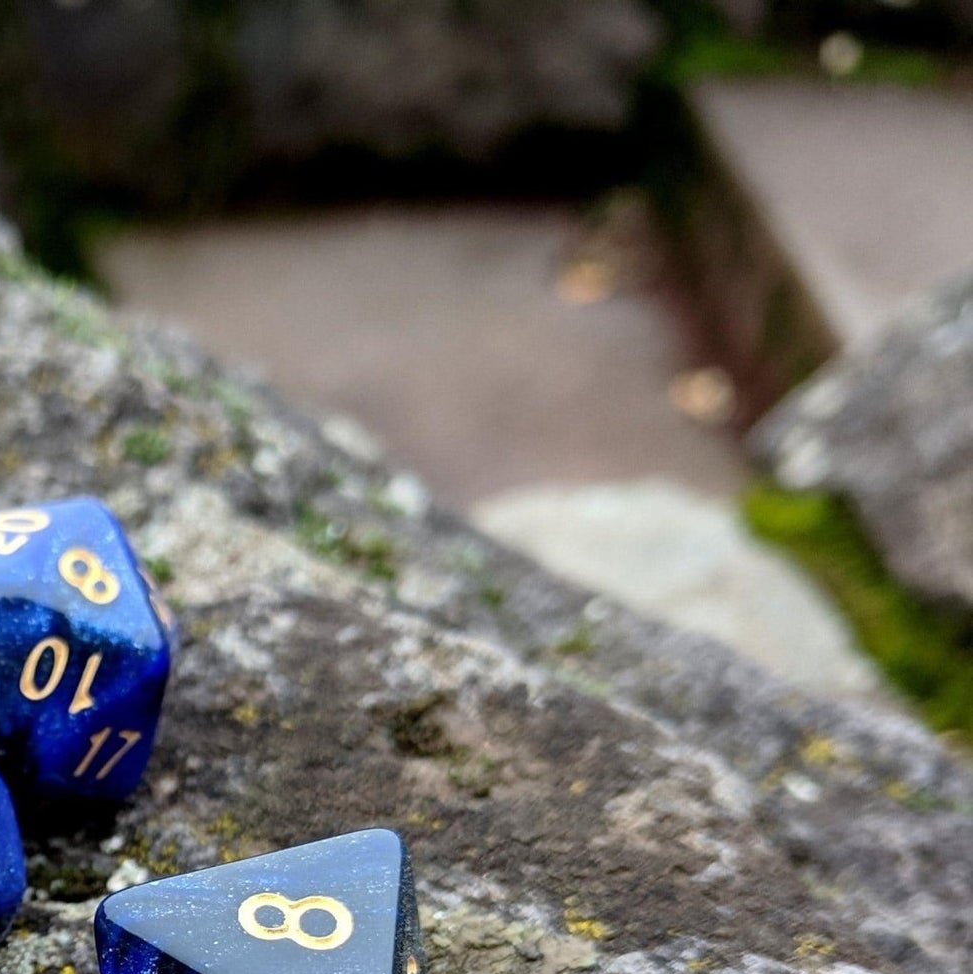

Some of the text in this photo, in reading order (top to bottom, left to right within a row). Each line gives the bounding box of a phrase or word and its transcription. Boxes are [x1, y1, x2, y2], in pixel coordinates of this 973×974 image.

[57, 547, 121, 605] 8
[19, 634, 104, 715] 10
[73, 726, 142, 781] 17
[237, 892, 355, 951] 8
